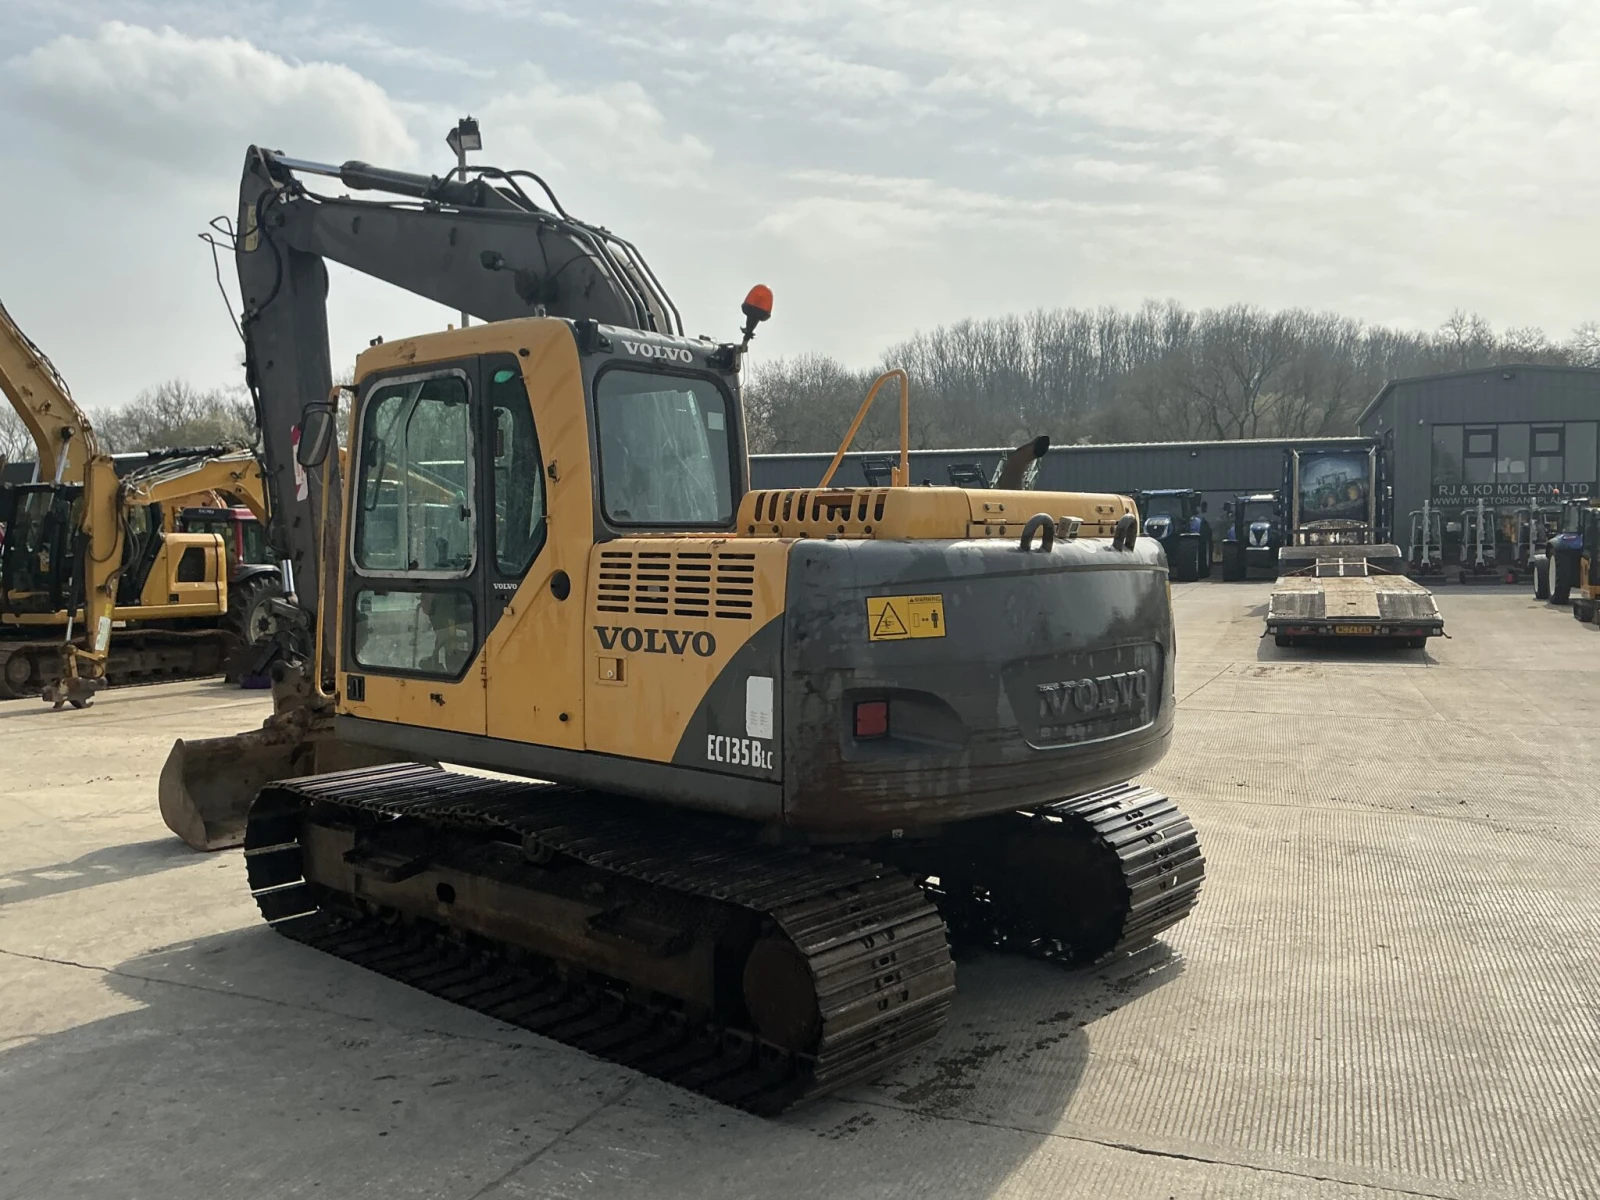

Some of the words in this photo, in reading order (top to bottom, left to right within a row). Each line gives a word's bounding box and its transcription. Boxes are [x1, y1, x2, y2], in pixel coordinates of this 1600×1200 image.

[621, 340, 693, 363] VOLVO
[1438, 484, 1456, 496] RJ
[1460, 484, 1469, 496] &
[1473, 484, 1493, 495] KD
[1497, 483, 1559, 495] MCLEAN
[1562, 483, 1589, 495] LTD
[593, 625, 717, 657] VOLVO
[1036, 668, 1150, 717] VOLVO
